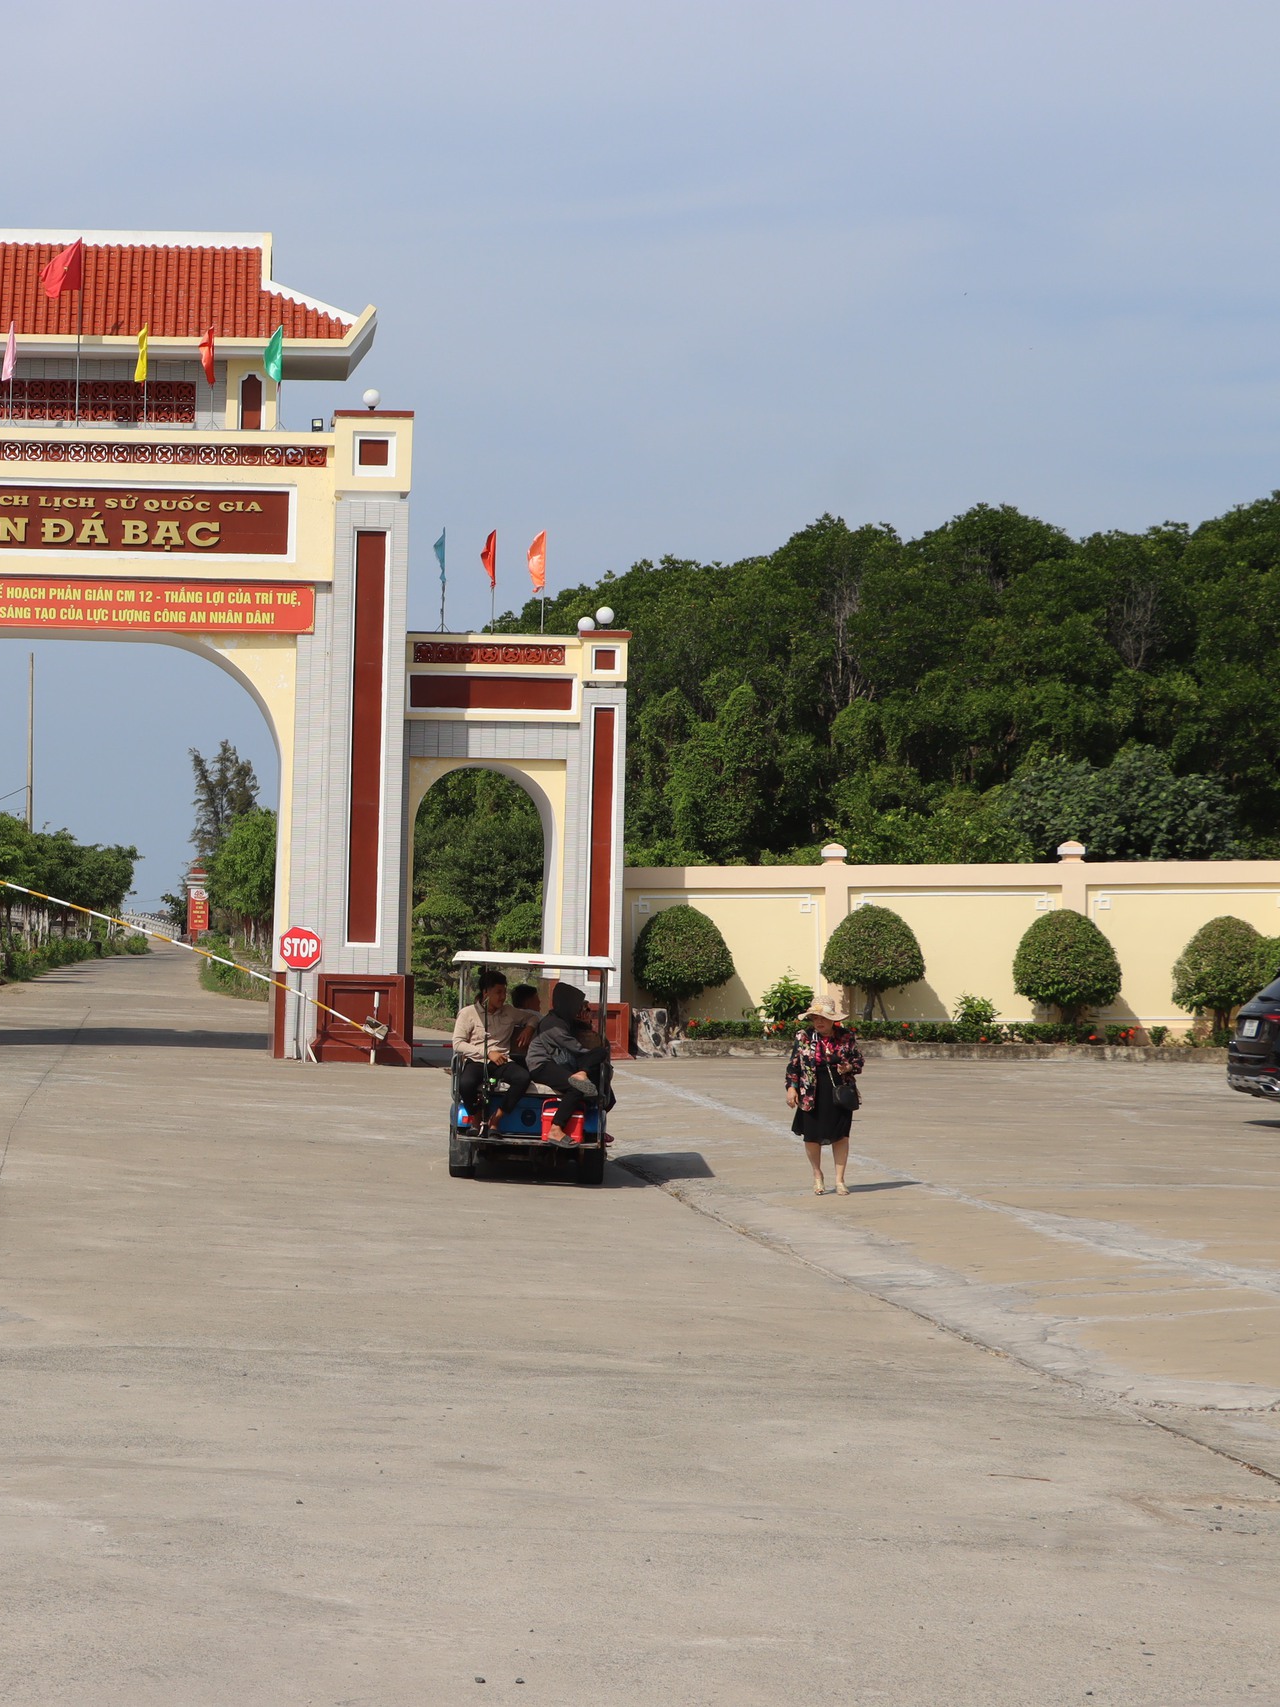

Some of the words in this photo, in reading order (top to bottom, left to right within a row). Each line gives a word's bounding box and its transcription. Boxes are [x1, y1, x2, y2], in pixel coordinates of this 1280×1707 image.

[38, 496, 96, 511] LỊCH
[105, 494, 139, 510] SỬ
[143, 494, 211, 512] QUỐC
[218, 501, 263, 513] GIA
[40, 511, 109, 545] ĐÁ
[121, 519, 220, 551] BẠC
[6, 586, 46, 602] HOẠCH
[49, 584, 81, 601] PHẢN
[84, 587, 113, 602] GIÁN
[116, 589, 135, 602] CM
[139, 590, 153, 603] 12
[164, 587, 203, 604] THẮNG
[206, 591, 225, 607] LỢI
[227, 588, 252, 604] CỦA
[255, 590, 273, 605] TRÍ
[276, 592, 301, 608] TUỆ,
[0, 604, 31, 619] SÁNG
[34, 607, 57, 622] TẠO
[60, 604, 84, 621] CỦA
[86, 608, 109, 624] LỰC
[112, 609, 151, 625] LƯỢNG
[153, 609, 186, 624] CÔNG
[189, 611, 206, 624] AN
[209, 609, 243, 624] NHÂN
[246, 609, 275, 625] DÂN!
[283, 937, 318, 958] STOP
